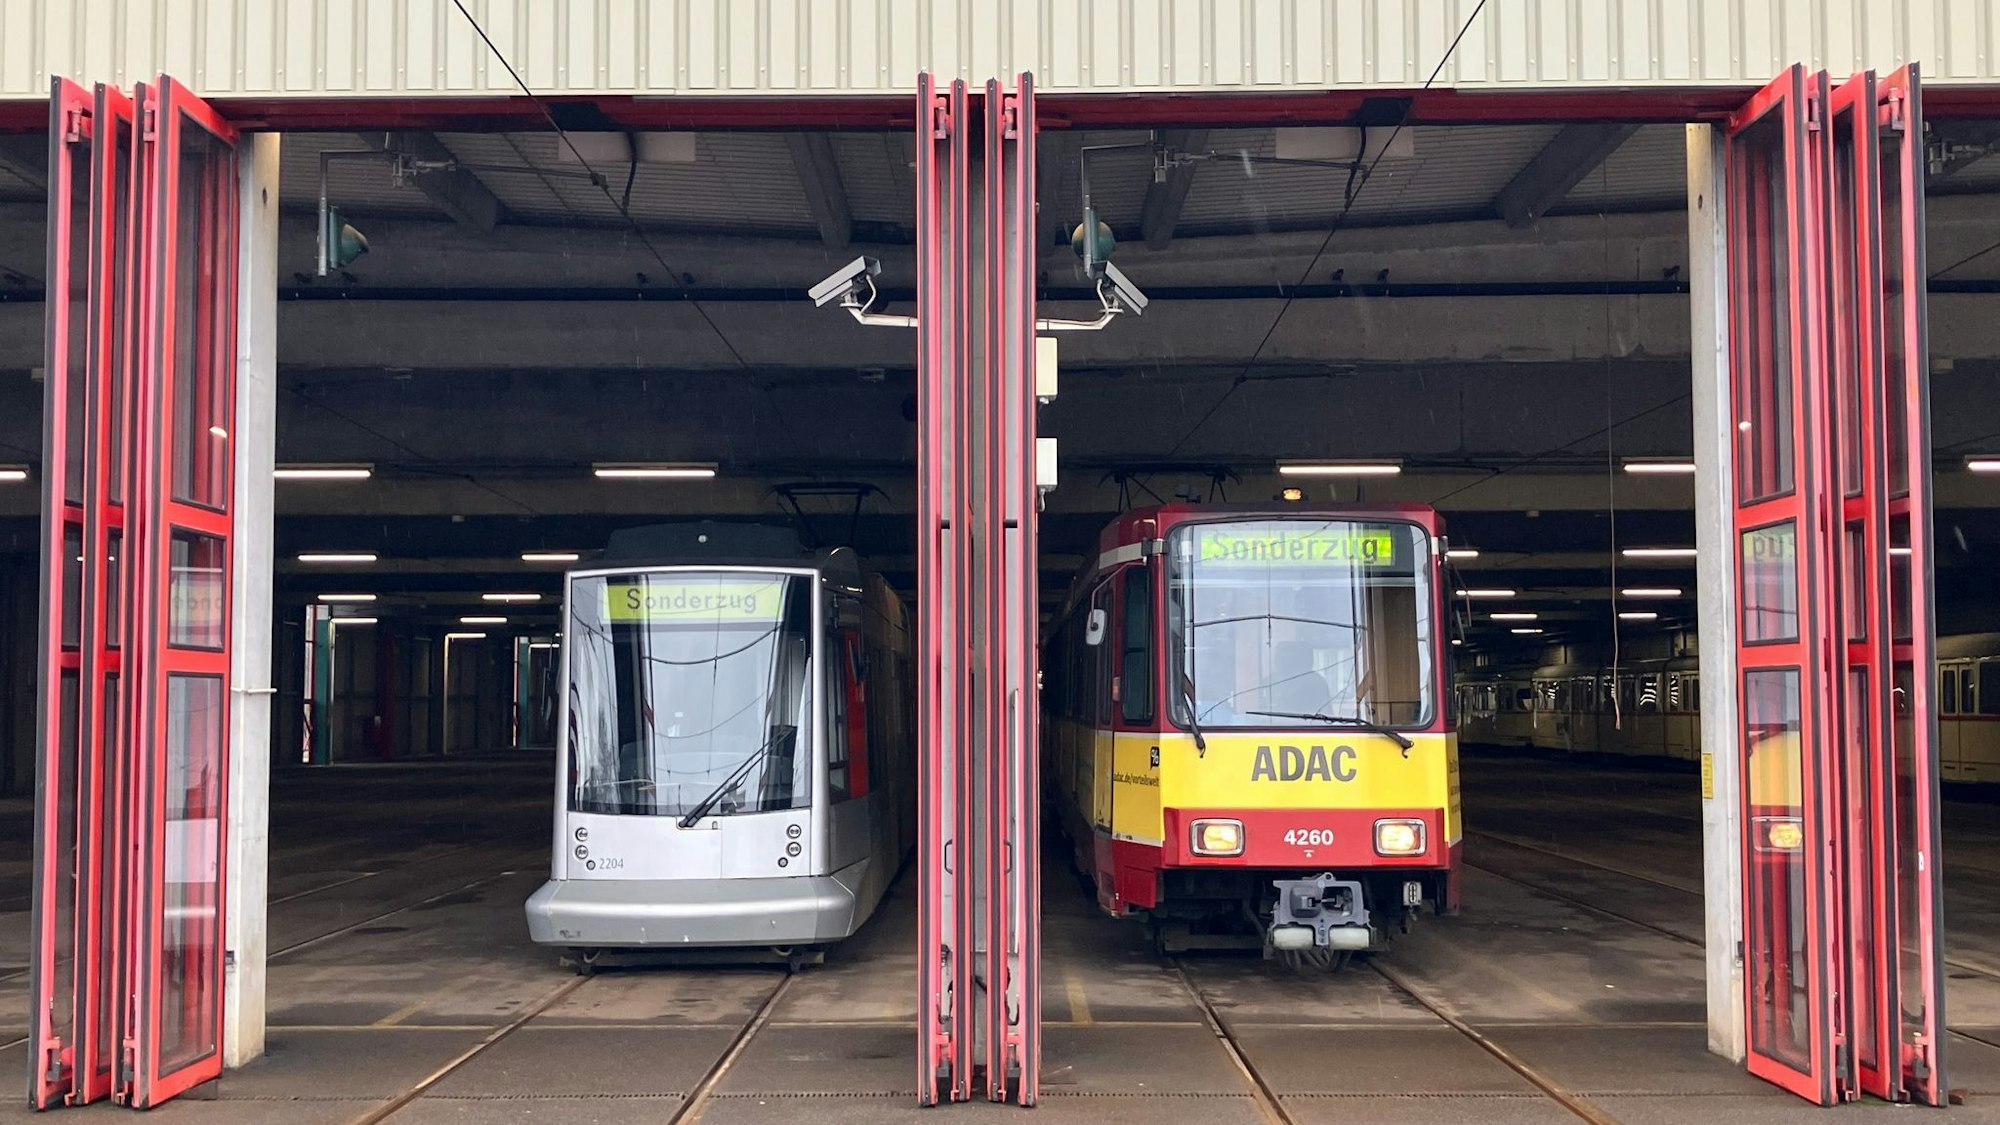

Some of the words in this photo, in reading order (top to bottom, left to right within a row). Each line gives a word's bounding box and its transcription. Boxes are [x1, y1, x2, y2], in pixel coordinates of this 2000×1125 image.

[1212, 532, 1378, 564] Sonderzug
[627, 588, 757, 614] Sonderzug
[1251, 745, 1357, 782] ADAC
[1283, 829, 1334, 846] 4260
[599, 857, 624, 870] 2204
